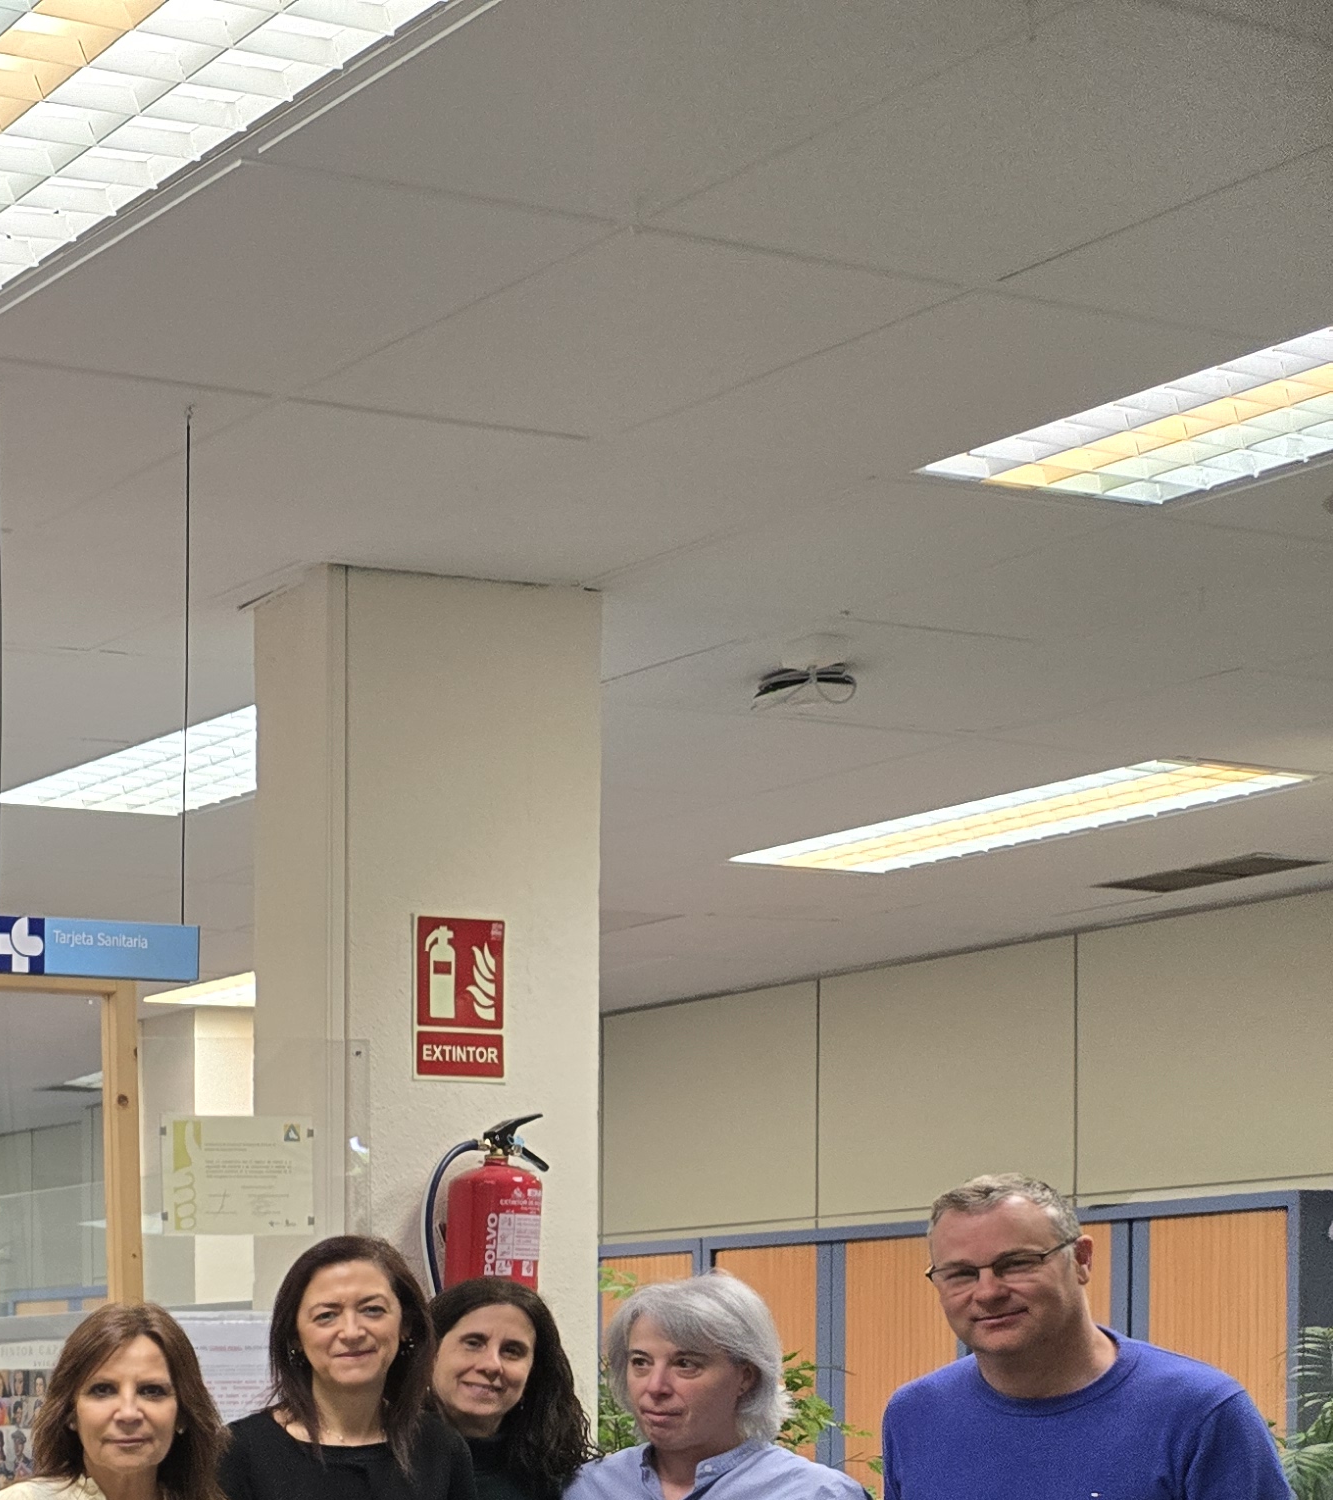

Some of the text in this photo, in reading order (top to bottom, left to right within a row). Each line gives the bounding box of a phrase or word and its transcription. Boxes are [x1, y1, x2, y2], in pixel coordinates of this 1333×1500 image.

[53, 930, 148, 949] Tarjeta Sanitaria
[422, 1043, 499, 1065] EXTINTOR
[483, 1212, 499, 1277] POLVO
